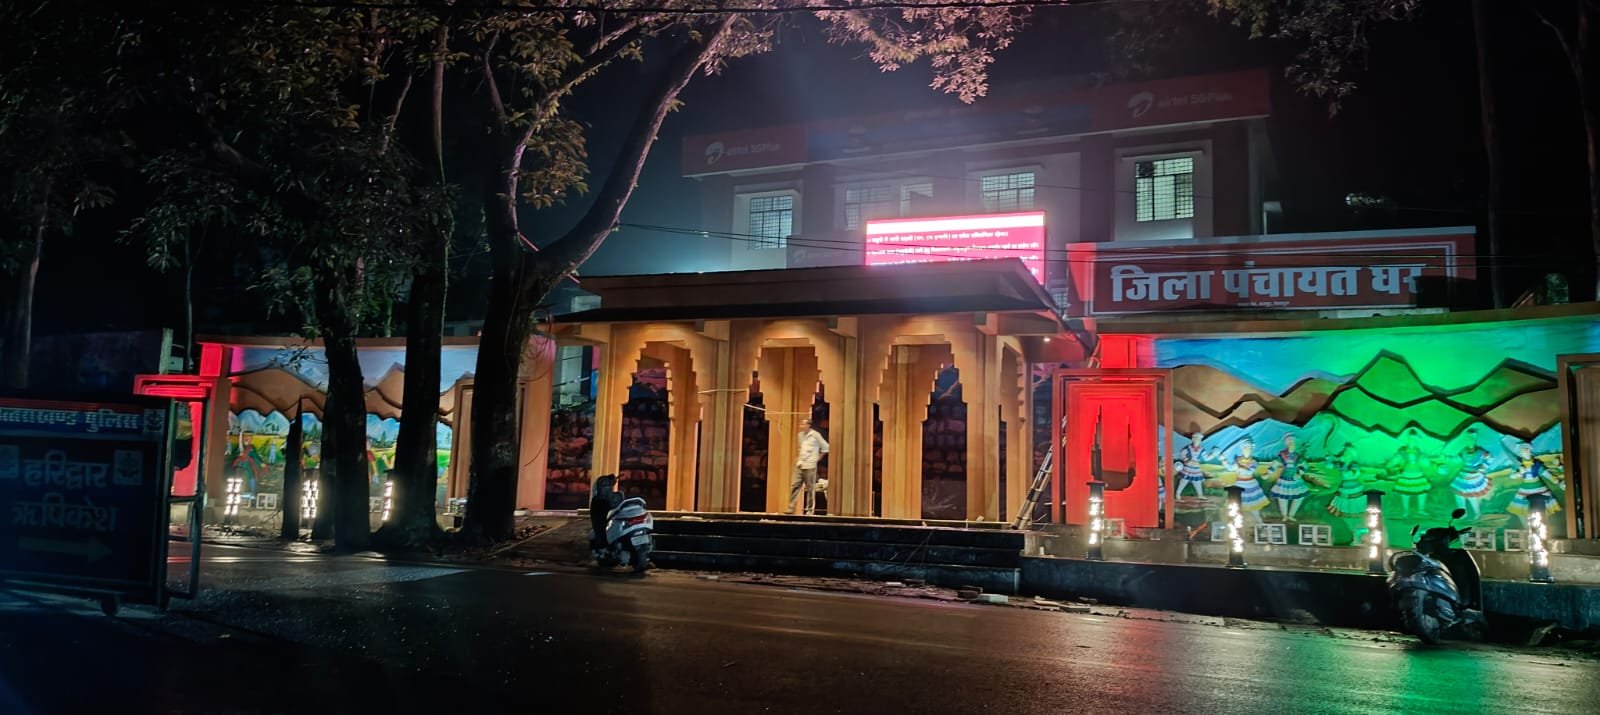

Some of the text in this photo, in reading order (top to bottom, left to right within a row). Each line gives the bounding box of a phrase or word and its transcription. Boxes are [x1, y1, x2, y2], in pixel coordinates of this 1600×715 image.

[1110, 260, 1426, 302] जिला पंचायत घर
[84, 408, 140, 433] पुलिस
[23, 448, 111, 490] हरिद्वार
[8, 491, 120, 532] ऋषिकेश
